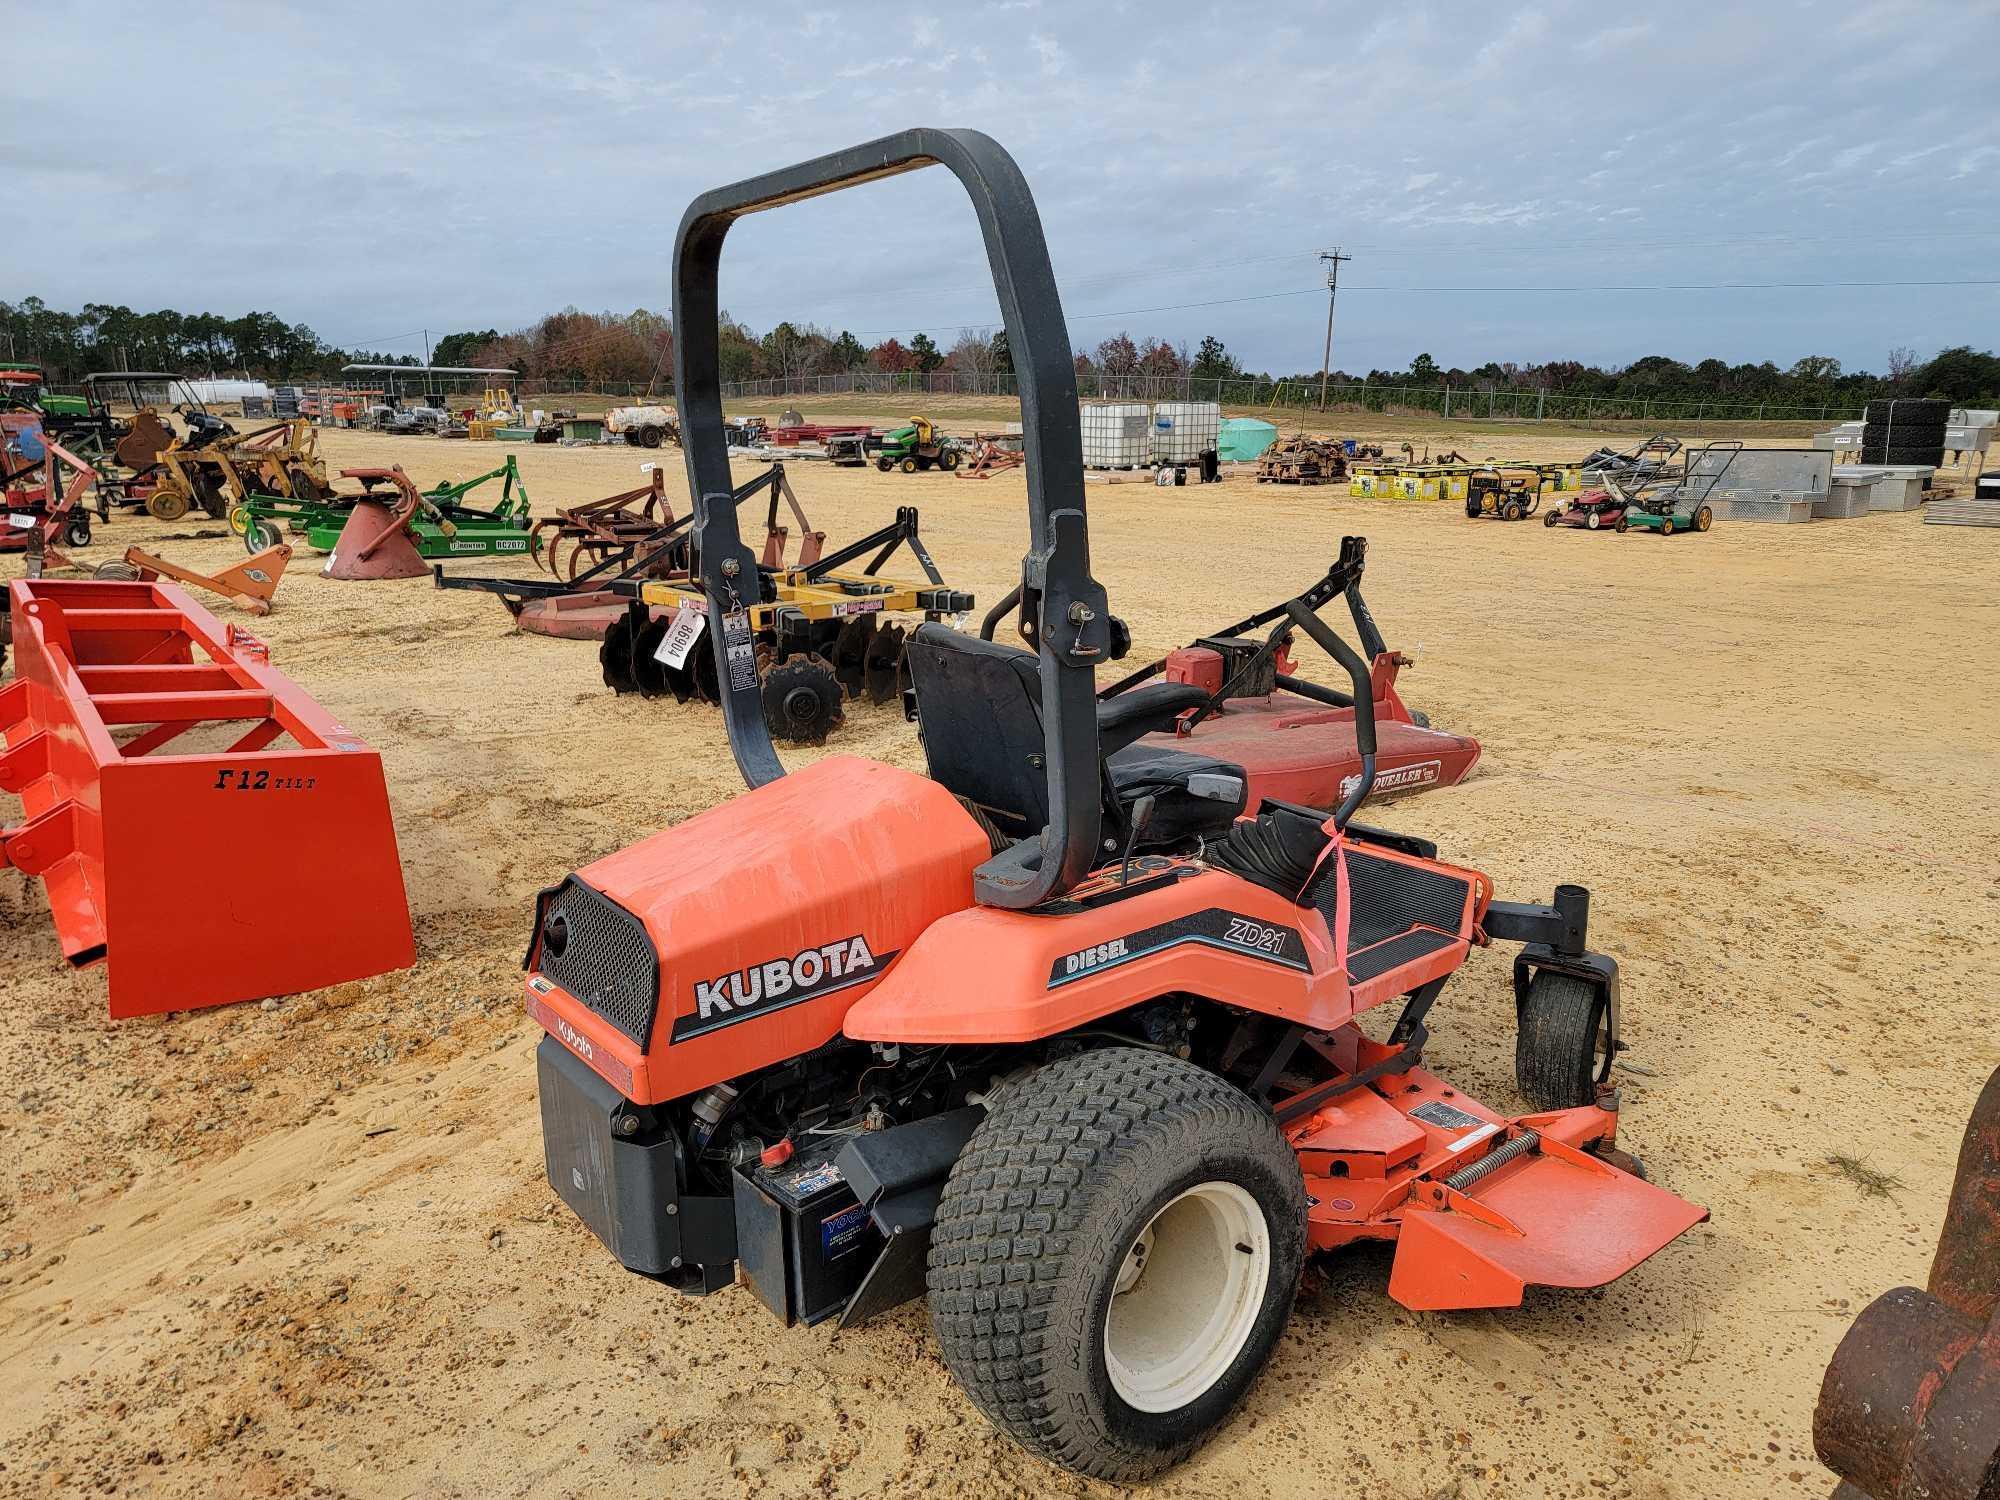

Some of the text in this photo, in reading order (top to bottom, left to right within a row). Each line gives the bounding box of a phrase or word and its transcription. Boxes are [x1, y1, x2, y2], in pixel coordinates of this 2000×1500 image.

[496, 540, 526, 550] RC2072
[667, 624, 694, 658] 86904
[1373, 769, 1422, 791] QUEALER
[1066, 917, 1287, 975] DIESEL ZD21
[696, 936, 875, 1020] KUBOTA
[557, 1018, 593, 1061] Kubota
